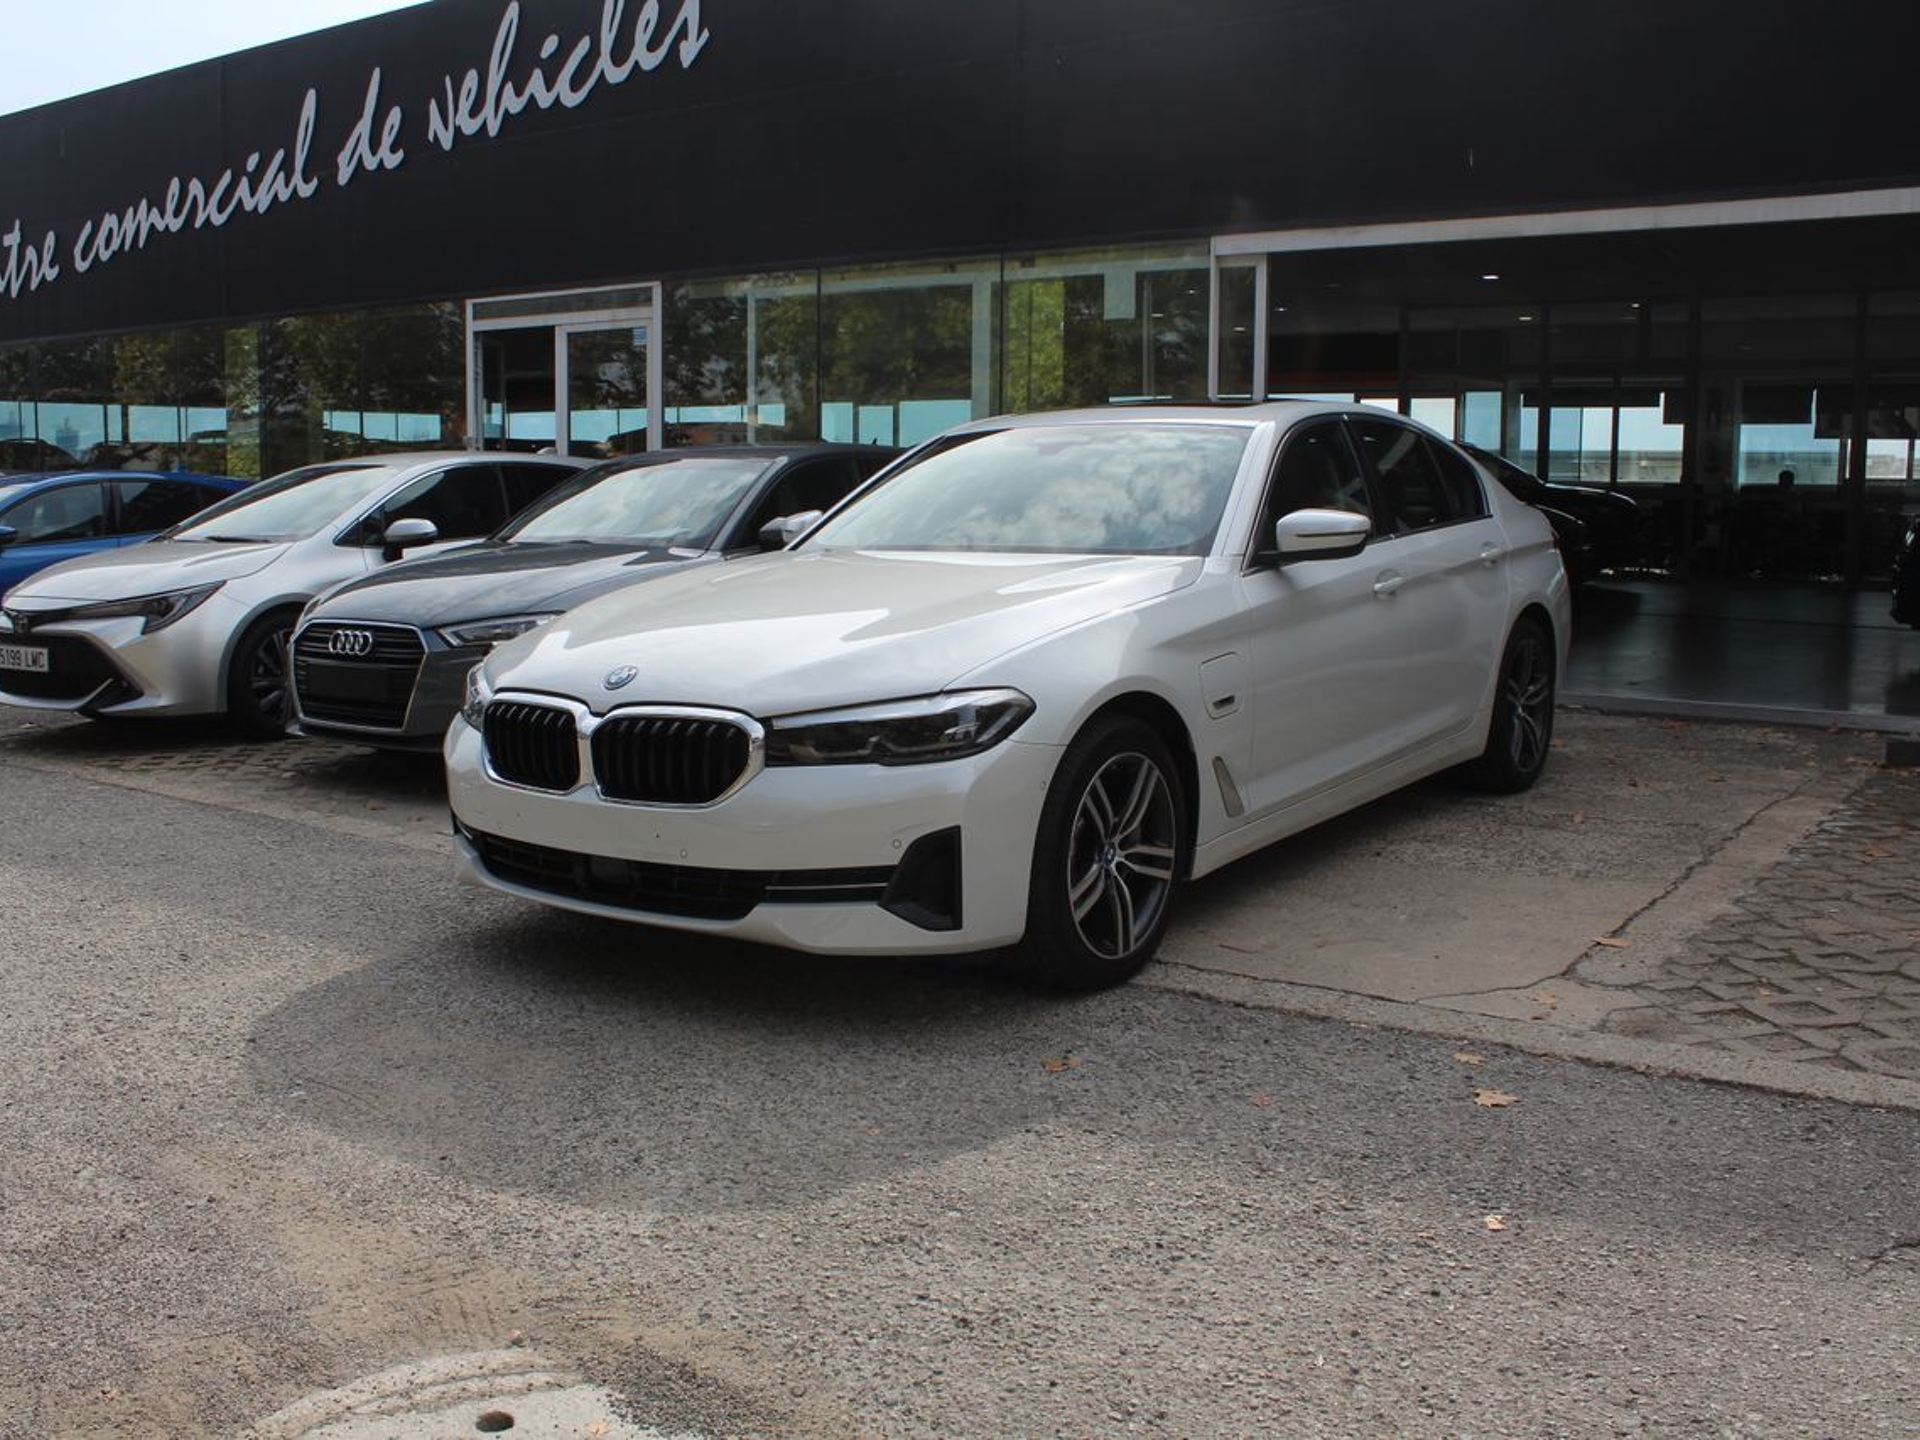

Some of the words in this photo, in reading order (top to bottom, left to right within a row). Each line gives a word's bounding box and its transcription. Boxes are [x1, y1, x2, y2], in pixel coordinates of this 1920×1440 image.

[0, 218, 60, 298] tre
[74, 88, 317, 273] comercial
[337, 68, 404, 186] de
[428, 0, 709, 150] vehicles
